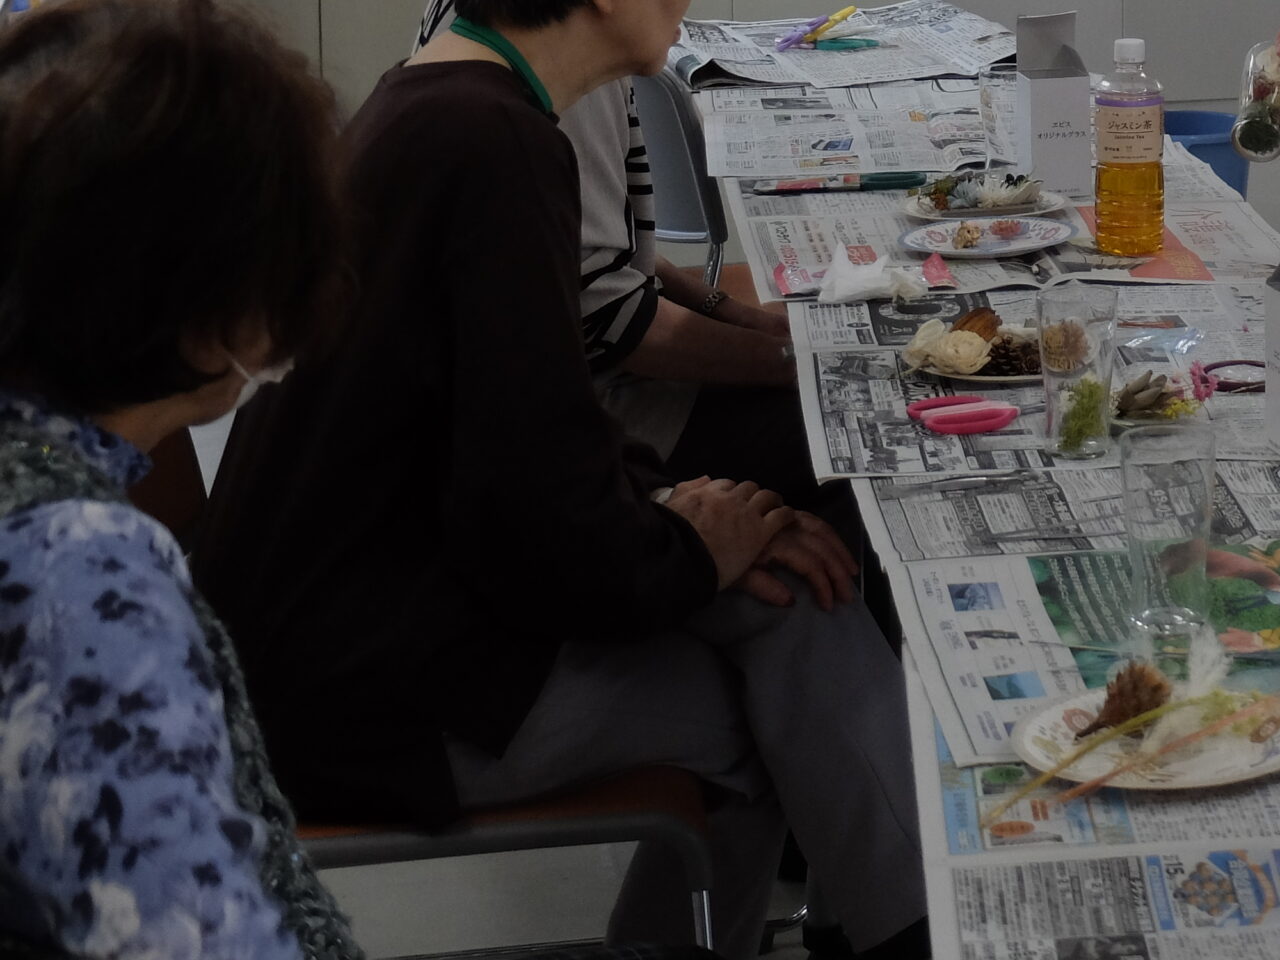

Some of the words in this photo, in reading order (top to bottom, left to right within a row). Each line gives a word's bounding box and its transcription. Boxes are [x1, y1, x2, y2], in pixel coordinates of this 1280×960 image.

[1108, 120, 1153, 130] ジャスミン茶
